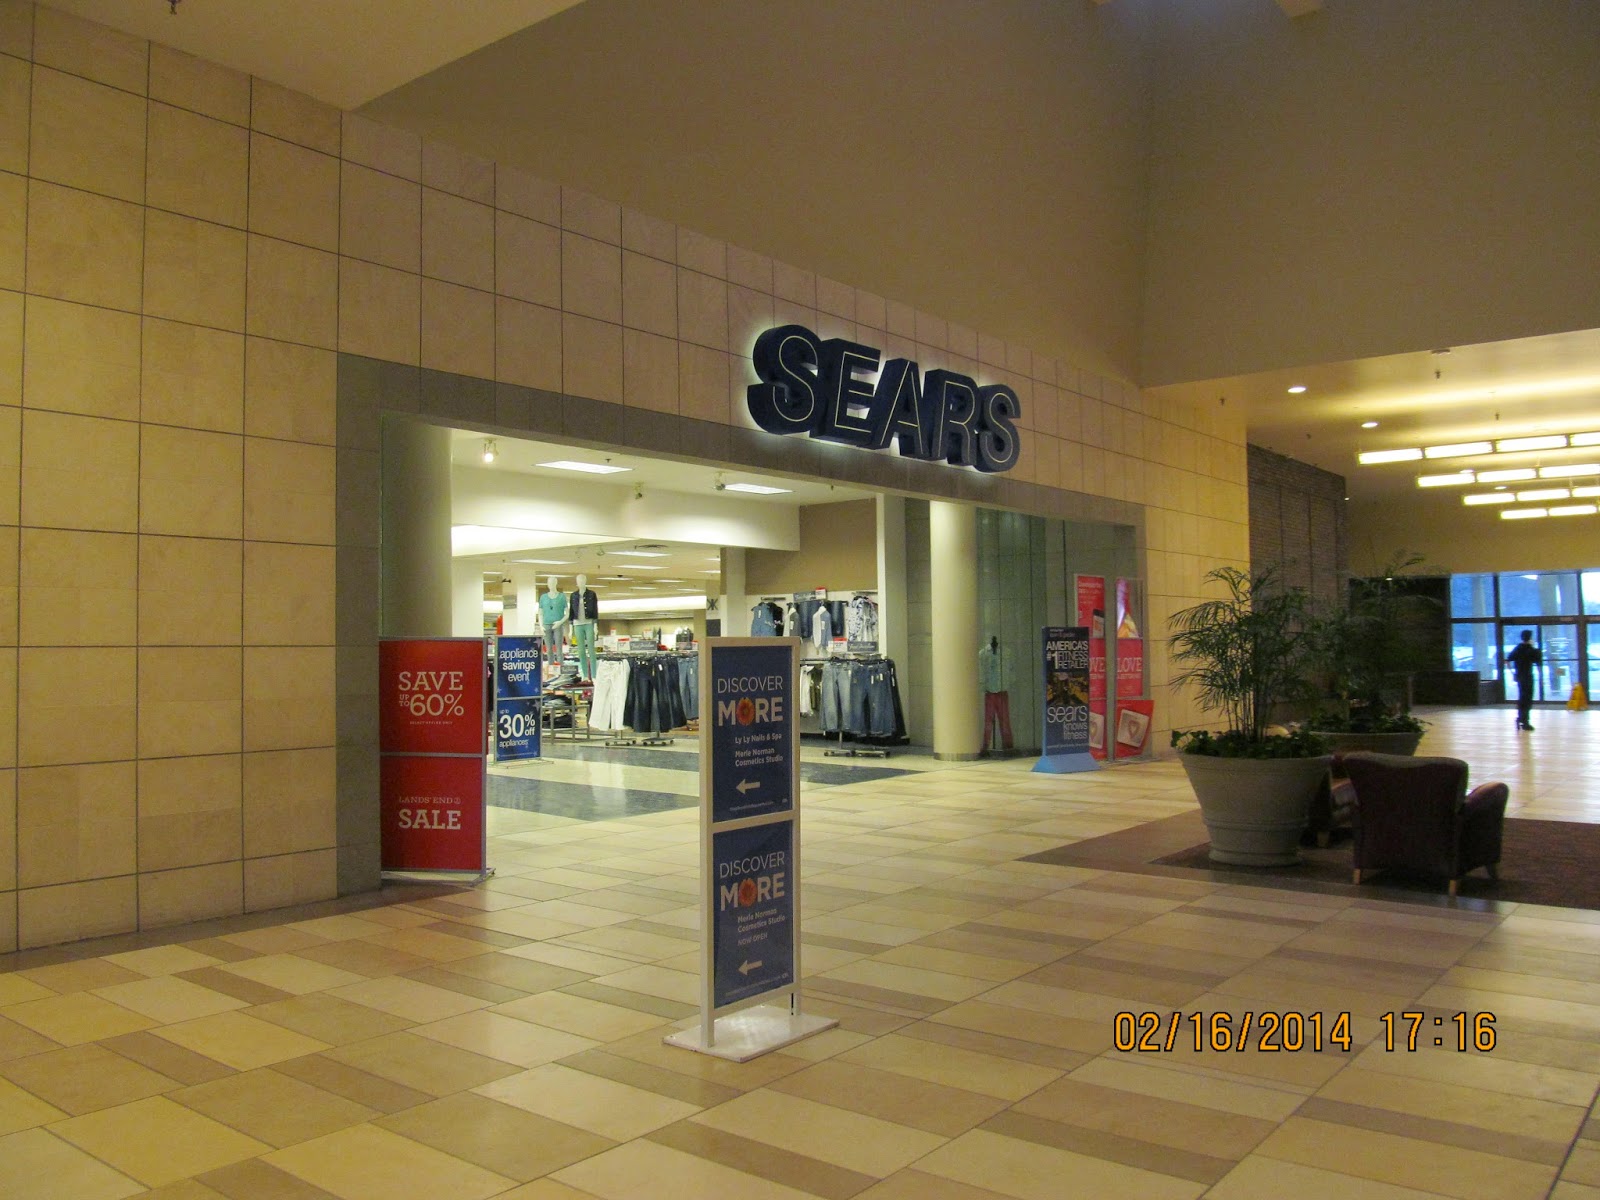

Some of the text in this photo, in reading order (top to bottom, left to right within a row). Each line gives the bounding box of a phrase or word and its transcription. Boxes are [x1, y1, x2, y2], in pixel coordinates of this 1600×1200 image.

[747, 324, 1021, 472] SEARS
[500, 647, 539, 660] appliance
[502, 659, 536, 672] savings
[398, 671, 464, 691] SAVE
[717, 675, 783, 694] DISCOVER
[410, 693, 464, 716] 60%
[1047, 705, 1088, 723] sears
[525, 727, 536, 737] off
[735, 757, 765, 767] Cosmetics
[398, 808, 461, 830] SALE
[720, 851, 785, 878] DISCOVER
